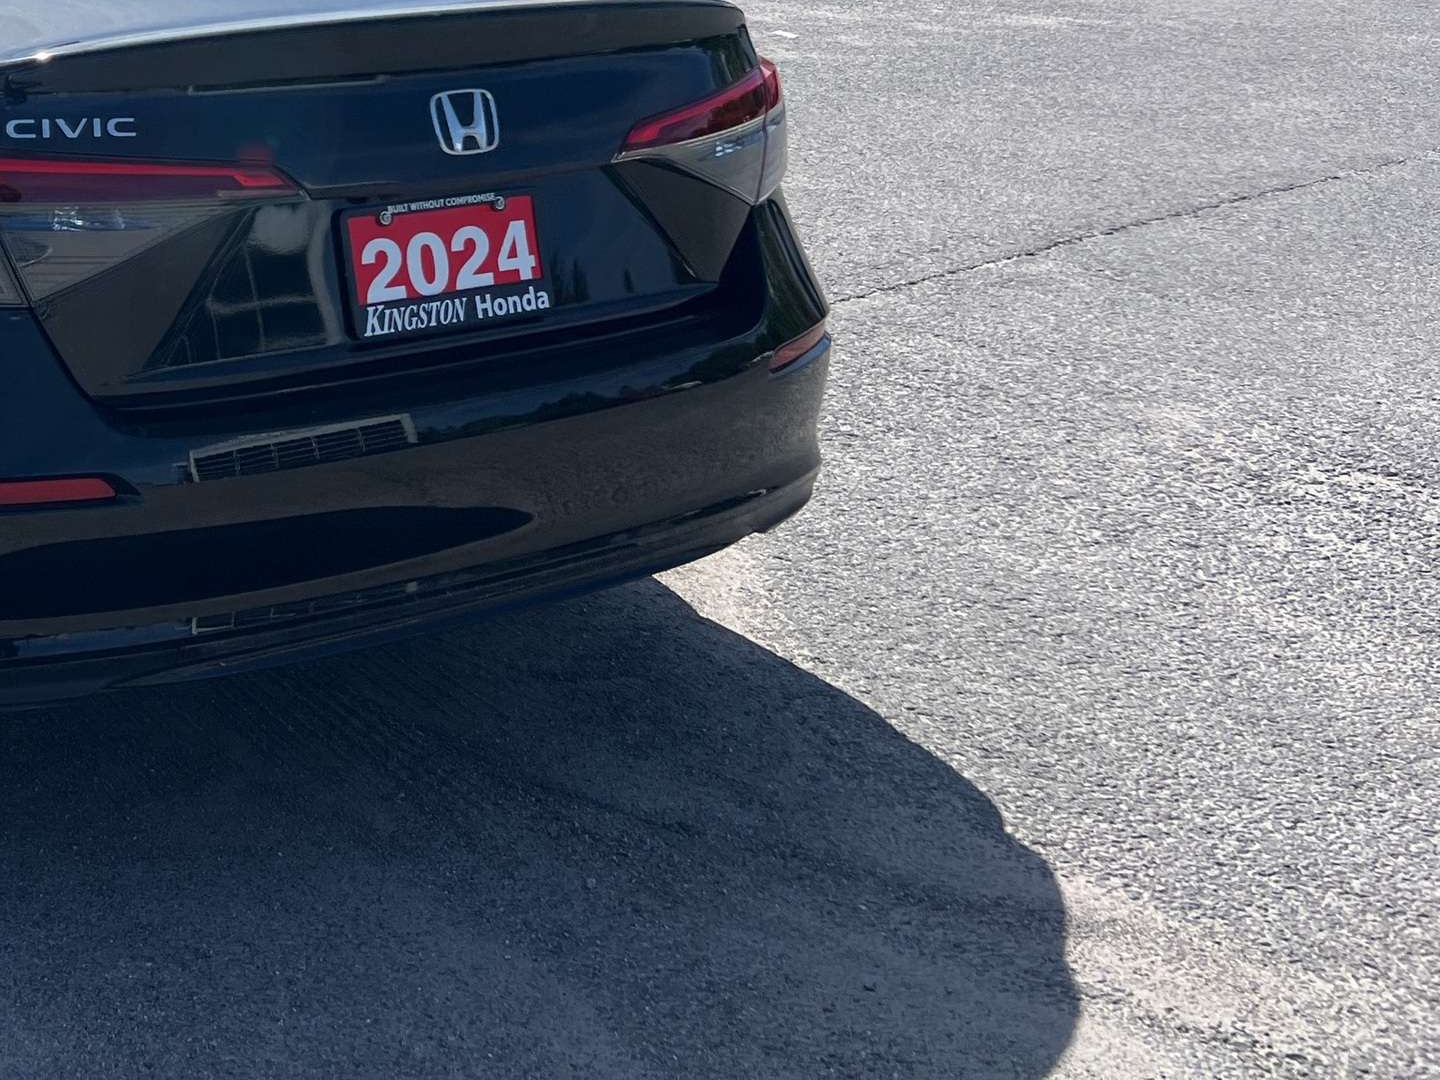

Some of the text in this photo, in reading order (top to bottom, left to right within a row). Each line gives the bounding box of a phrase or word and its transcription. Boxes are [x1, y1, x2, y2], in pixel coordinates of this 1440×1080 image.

[5, 117, 137, 139] CIVIC
[409, 198, 445, 211] WITHOUT
[445, 192, 497, 207] COMPROMISE
[361, 219, 537, 305] 2024
[364, 286, 550, 337] KINGSTON Honda
